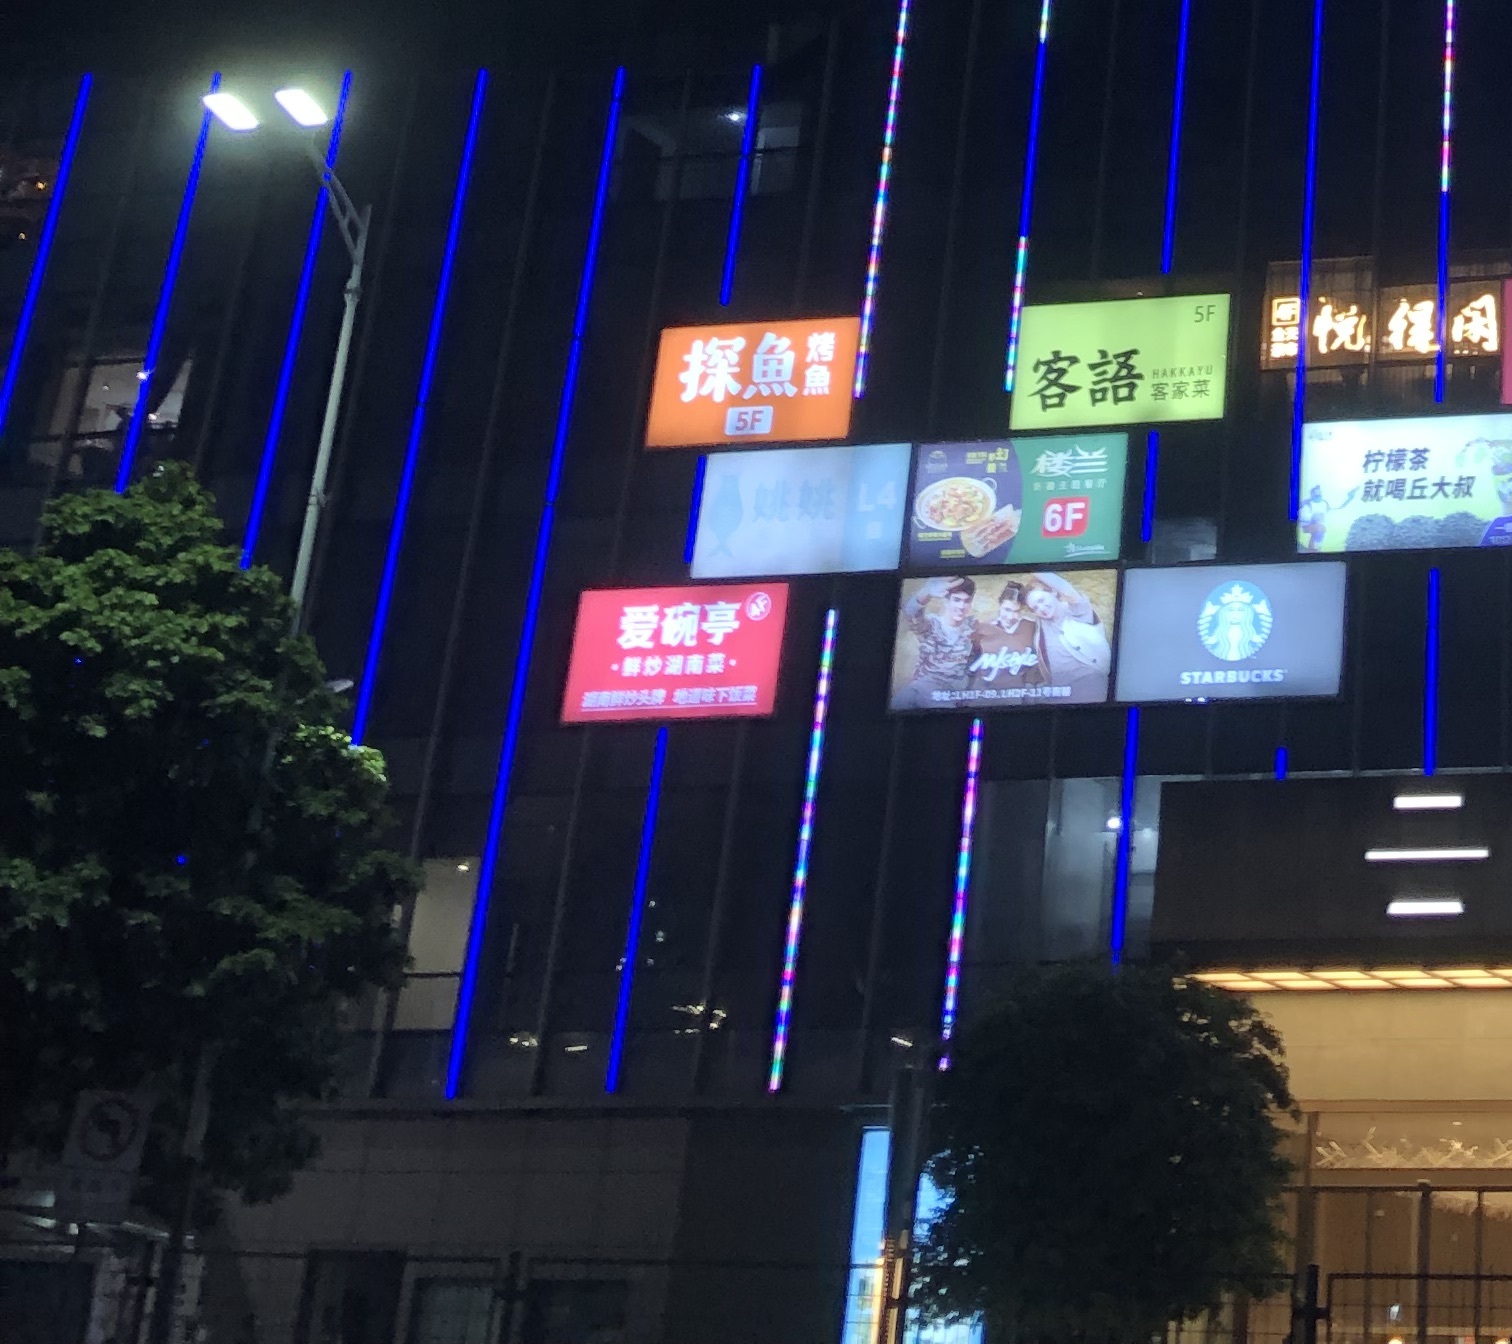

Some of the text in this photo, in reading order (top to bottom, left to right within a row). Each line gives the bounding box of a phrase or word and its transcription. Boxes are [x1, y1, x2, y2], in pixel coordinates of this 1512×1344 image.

[1195, 304, 1217, 324] 5F
[678, 332, 798, 404] 探魚
[1028, 348, 1146, 413] 客語
[1152, 364, 1214, 380] HAKKAYU
[1151, 379, 1212, 401] 客家菜
[734, 410, 765, 432] 5F
[1362, 447, 1430, 473] 柠檬茶
[858, 480, 897, 513] L4
[1360, 475, 1477, 503] 就喝丘大叔
[1044, 501, 1086, 533] 6F
[615, 601, 742, 650] 爱碗亭
[1180, 667, 1283, 685] STARBUCKS
